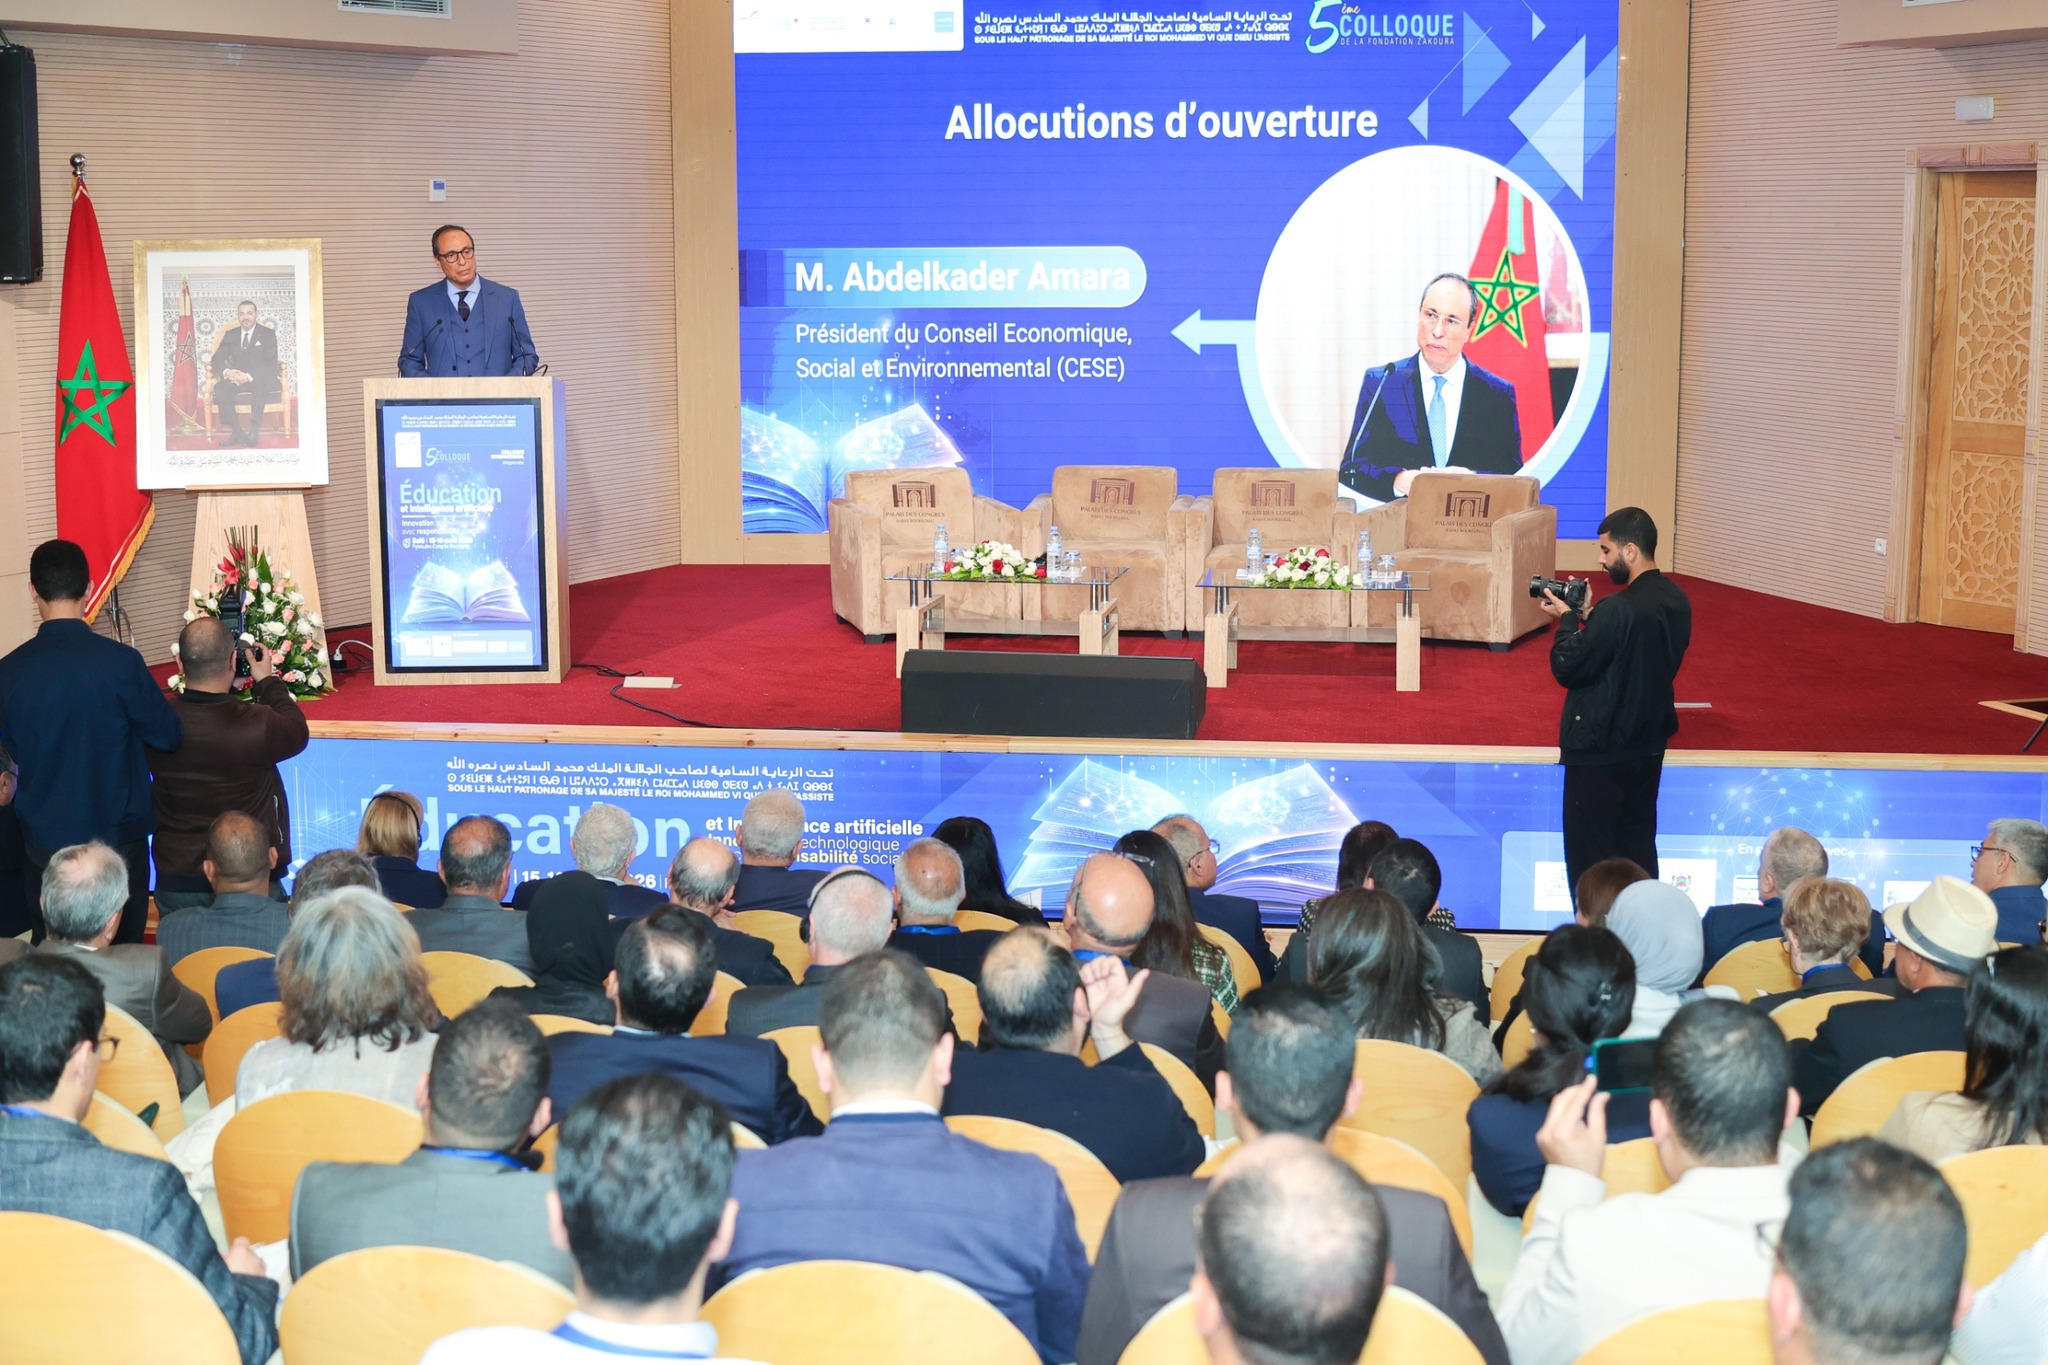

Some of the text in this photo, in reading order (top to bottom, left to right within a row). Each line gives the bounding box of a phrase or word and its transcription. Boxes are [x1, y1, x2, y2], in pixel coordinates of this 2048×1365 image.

[974, 11, 1293, 27] تحت الرعاية السامية لصاحب الجلالة الملك محمد السادس نصره الله
[1305, 0, 1343, 54] 5
[1339, 14, 1454, 38] COLLOQUE
[974, 35, 996, 43] SOUS
[997, 35, 1007, 43] LE
[1007, 35, 1028, 43] HAUT
[1029, 35, 1075, 43] PATRONAGE
[1099, 33, 1133, 42] MAJESTÉ
[1134, 34, 1144, 42] LE
[1144, 34, 1158, 42] ROI
[1159, 34, 1206, 42] MOHAMMED
[1216, 34, 1233, 42] QUE
[1234, 33, 1253, 41] DIEU
[1254, 33, 1290, 41] L'ASSISTE
[1340, 38, 1351, 46] DE
[1368, 37, 1414, 45] FONDATION
[1417, 37, 1455, 45] ZAKOURA
[944, 101, 1378, 140] Allocutions d'ouverture
[795, 261, 1130, 292] M. Abdelkader Amara
[795, 322, 1133, 347] Président du Conseil Economique,
[795, 355, 1126, 382] Social et Environnemental (CESE)
[434, 452, 471, 461] COLLOQUE
[400, 478, 502, 504] Éducation
[400, 505, 409, 513] et
[410, 504, 455, 515] Intelligence
[402, 519, 435, 527] Innovation
[447, 756, 834, 780] تحت الرعاية السامية لصاحب الجلالة الملك محمد السادس نصره الله
[448, 784, 473, 793] SOUS
[475, 785, 486, 793] LE
[488, 785, 513, 793] HAUT
[514, 785, 569, 795] PATRONAGE
[571, 787, 583, 795] DE
[585, 788, 598, 796] SA
[599, 787, 640, 797] MAJESTÉ
[642, 789, 653, 797] LE
[655, 789, 671, 798] ROI
[673, 790, 730, 799] MOHAMMED
[732, 791, 742, 799] VI
[793, 792, 834, 801] 'ASSISTE
[705, 816, 724, 831] et
[834, 819, 924, 836] artificielle
[803, 835, 900, 853] echnologique
[1738, 843, 1753, 854] En
[863, 851, 905, 865] socia
